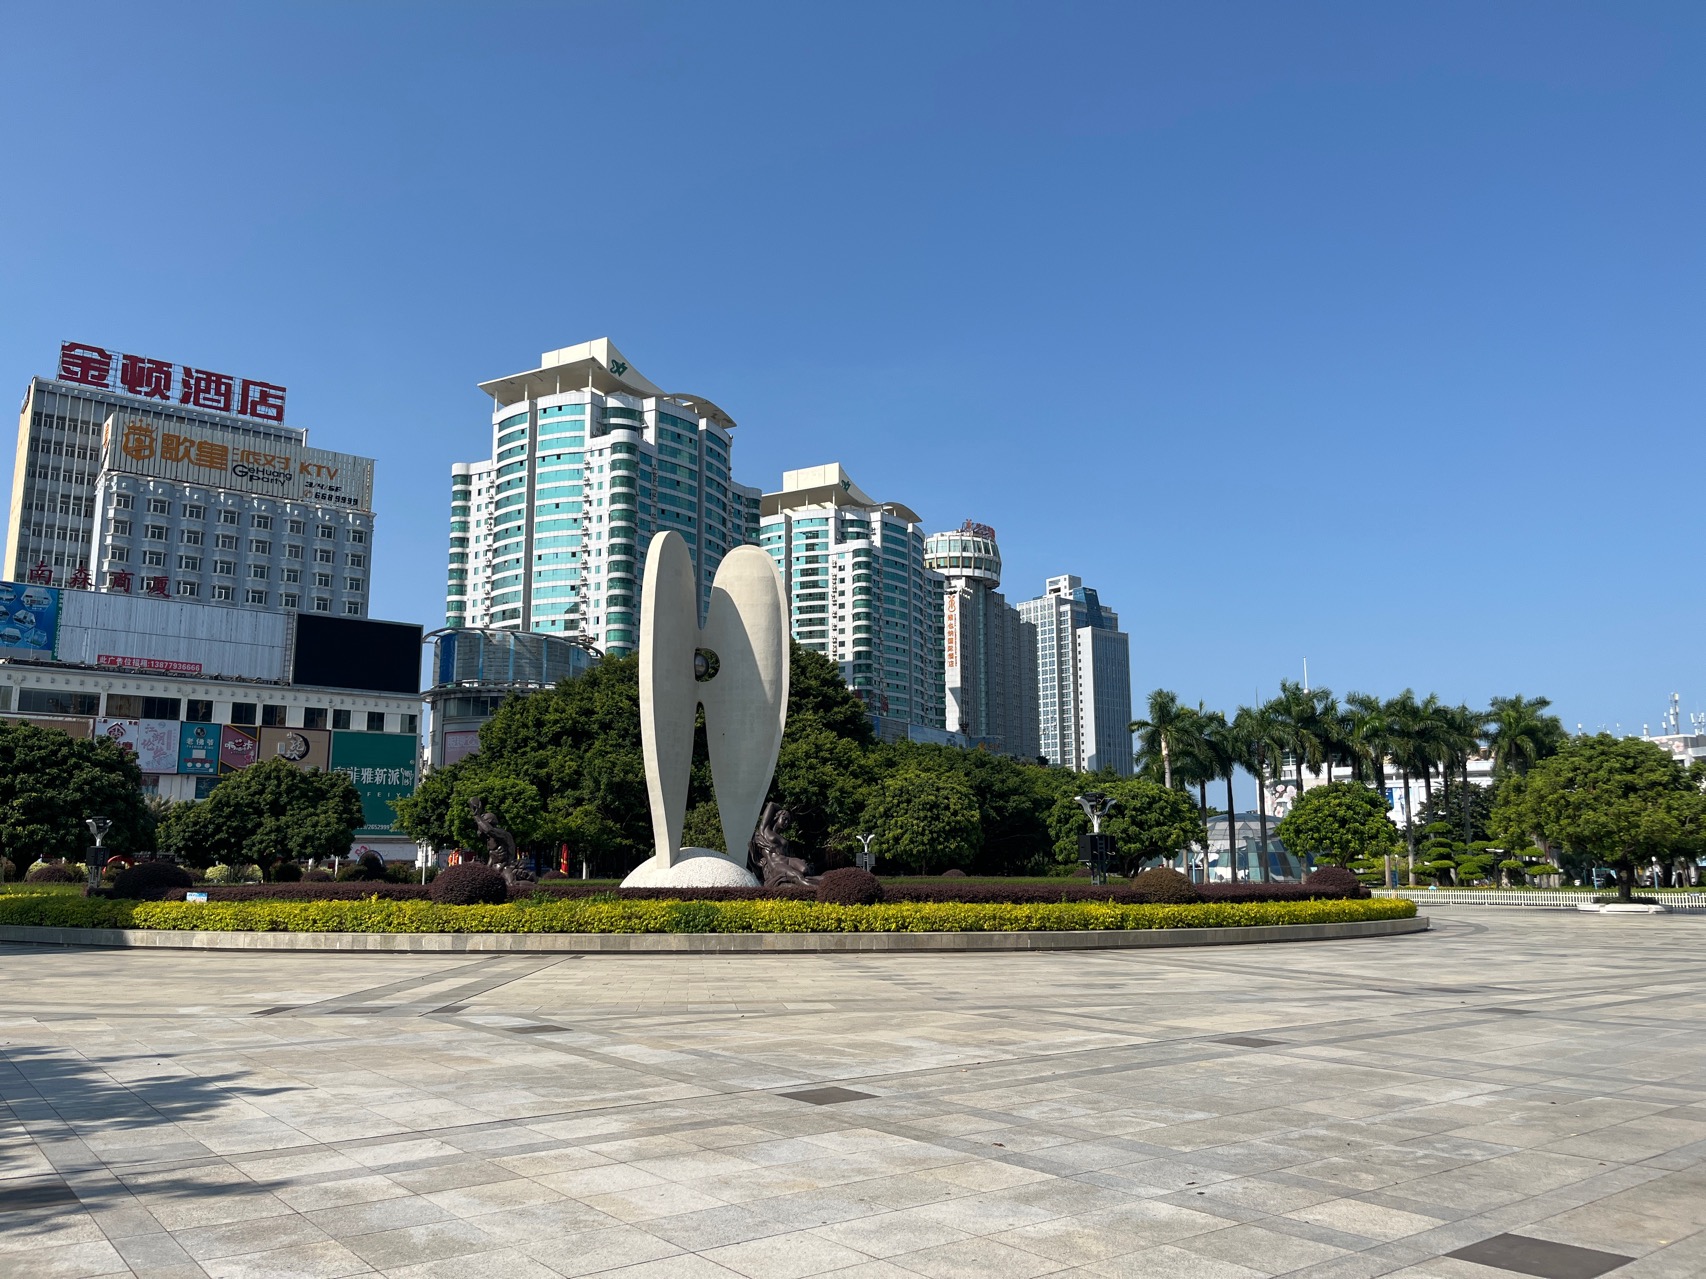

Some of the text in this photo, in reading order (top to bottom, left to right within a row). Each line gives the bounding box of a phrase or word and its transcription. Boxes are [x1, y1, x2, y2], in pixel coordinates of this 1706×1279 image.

[59, 342, 286, 422] 金顿酒店
[161, 433, 229, 471] 歌皇
[299, 461, 338, 480] KTV
[232, 464, 292, 481] GeHuang
[29, 559, 172, 599] 南森商厦
